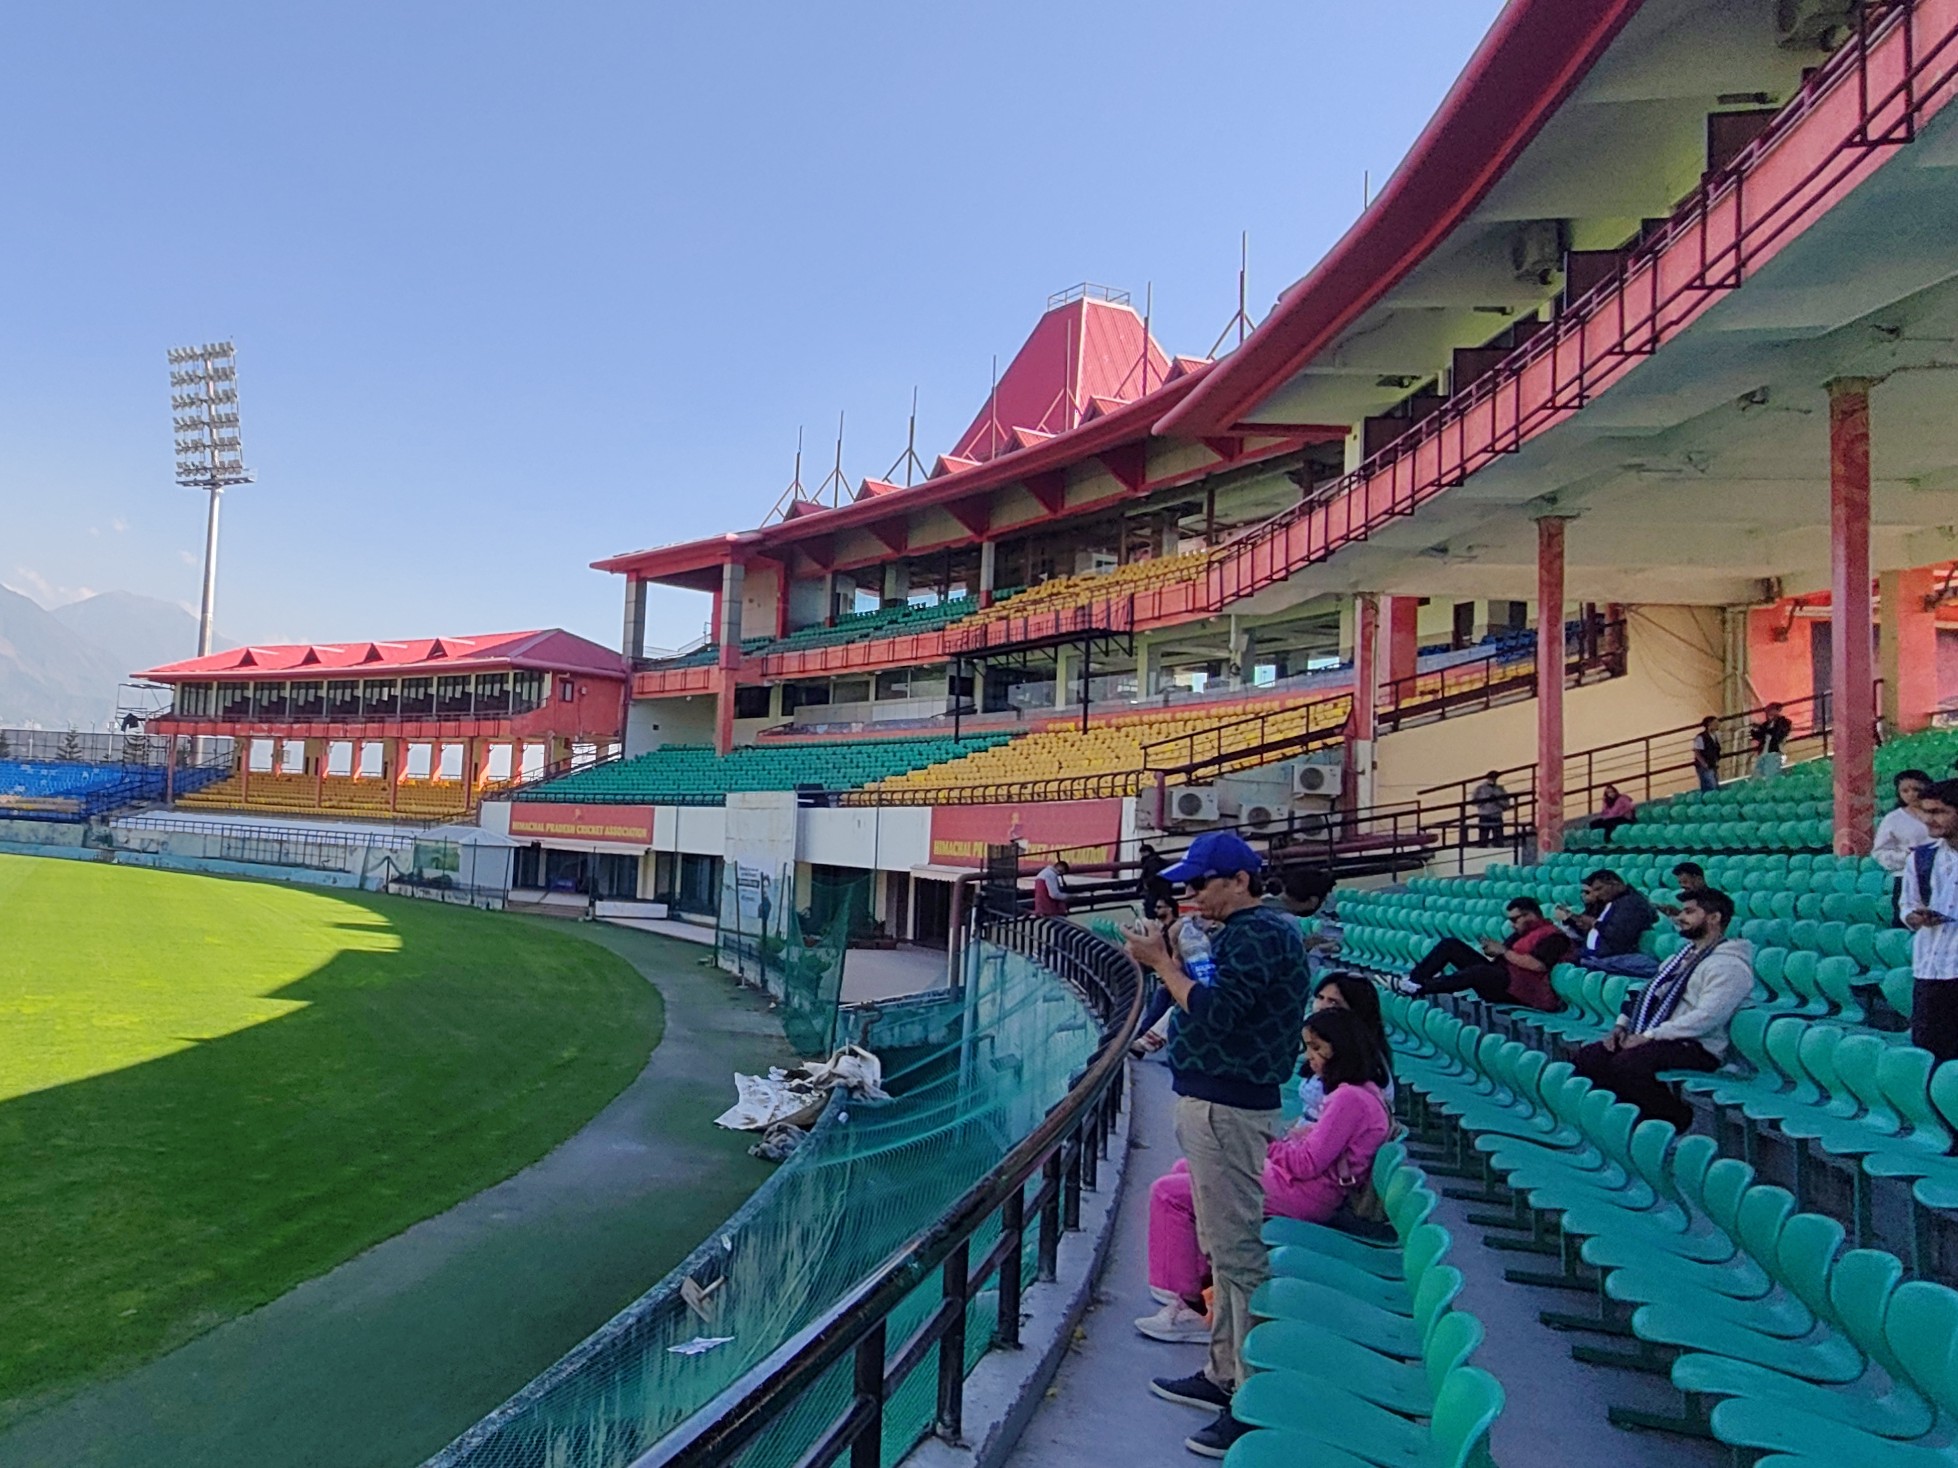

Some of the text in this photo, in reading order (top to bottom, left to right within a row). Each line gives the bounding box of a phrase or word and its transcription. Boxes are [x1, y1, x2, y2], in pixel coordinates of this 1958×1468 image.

[512, 821, 648, 838] HIMACHAL PRADESH CRICKET ASSOCIATION
[934, 840, 972, 857] HIMACHAL
